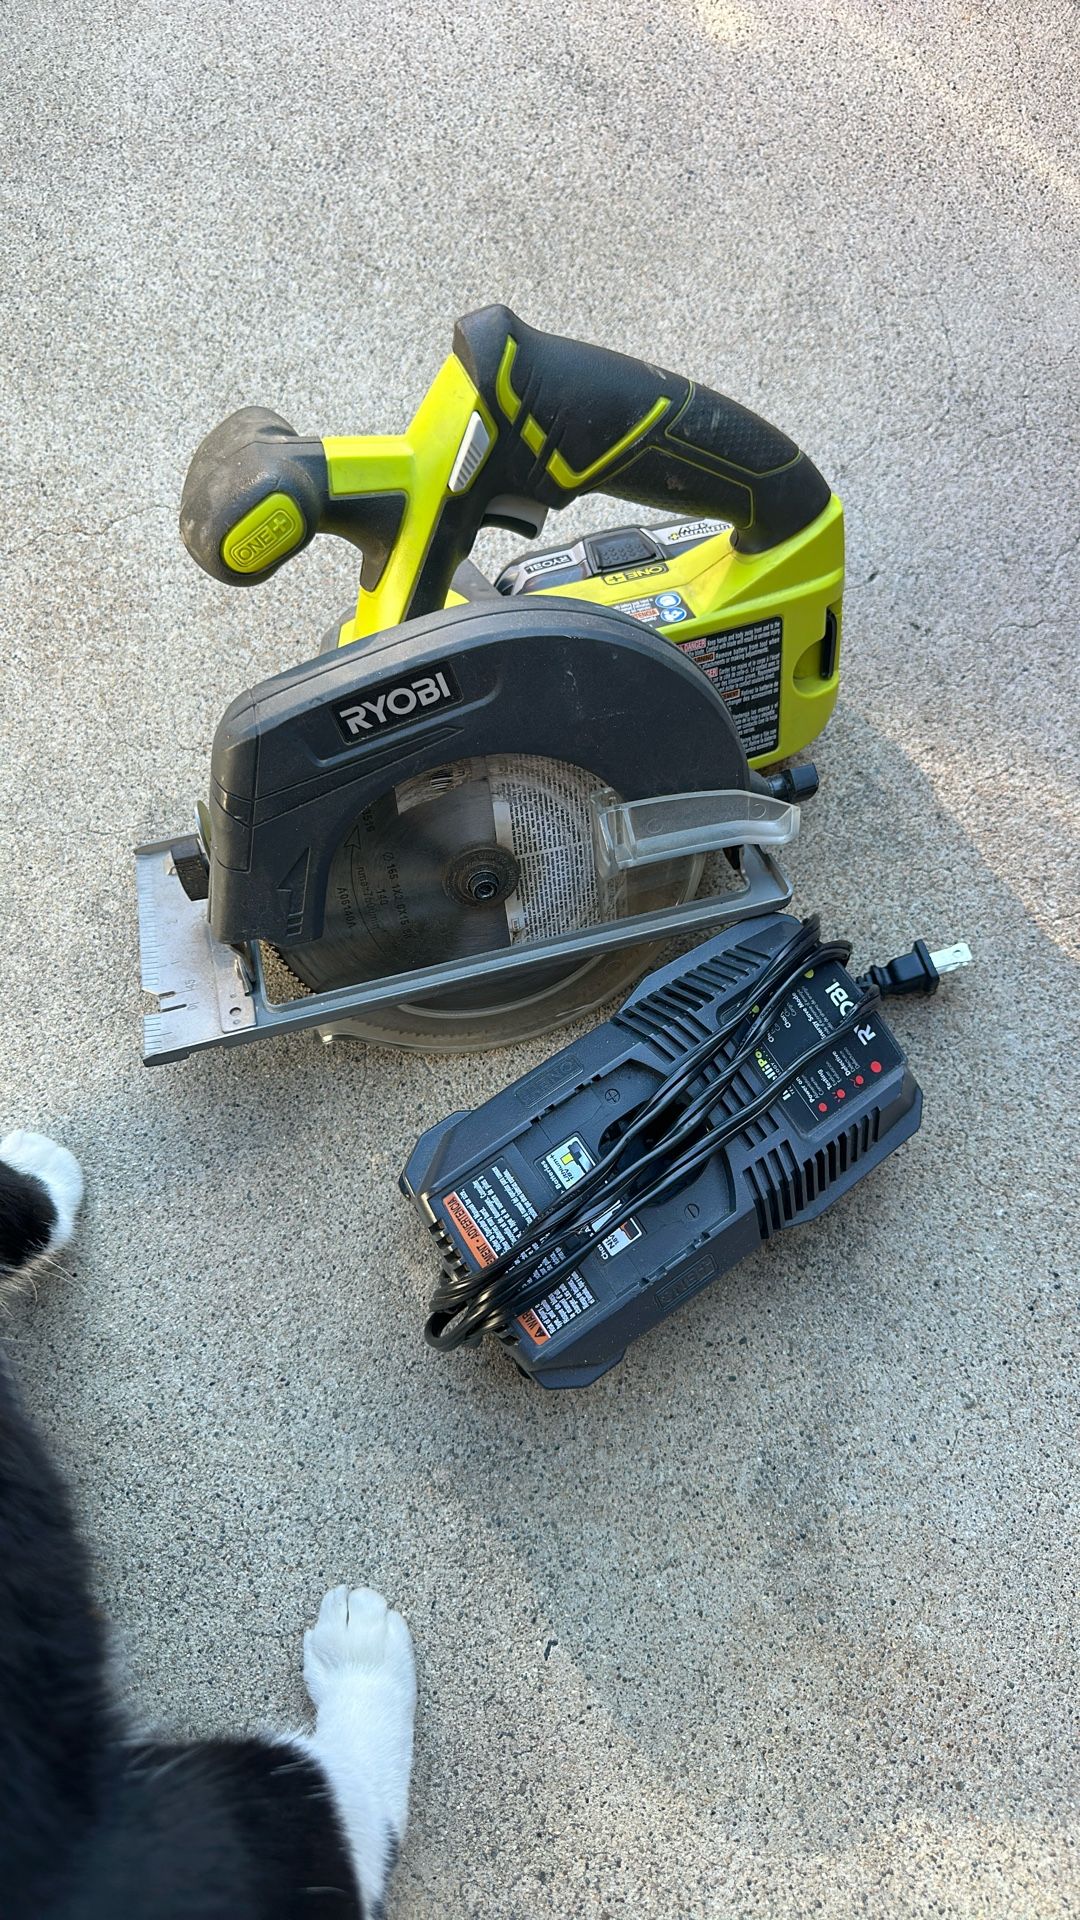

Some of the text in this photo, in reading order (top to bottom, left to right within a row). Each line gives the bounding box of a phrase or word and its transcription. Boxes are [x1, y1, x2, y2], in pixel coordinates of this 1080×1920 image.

[236, 514, 290, 563] ONE+
[528, 555, 570, 571] RYOBI
[608, 564, 662, 582] ONE+
[339, 671, 451, 736] RYOBI
[789, 992, 804, 1008] Mode
[824, 981, 877, 1045] ROBI
[800, 1007, 813, 1022] Save
[830, 1050, 851, 1076] Defective
[794, 1076, 815, 1102] Power on
[815, 1068, 833, 1090] Testing
[539, 1159, 561, 1189] Batteries
[445, 1197, 480, 1239] ADVERTENCIA
